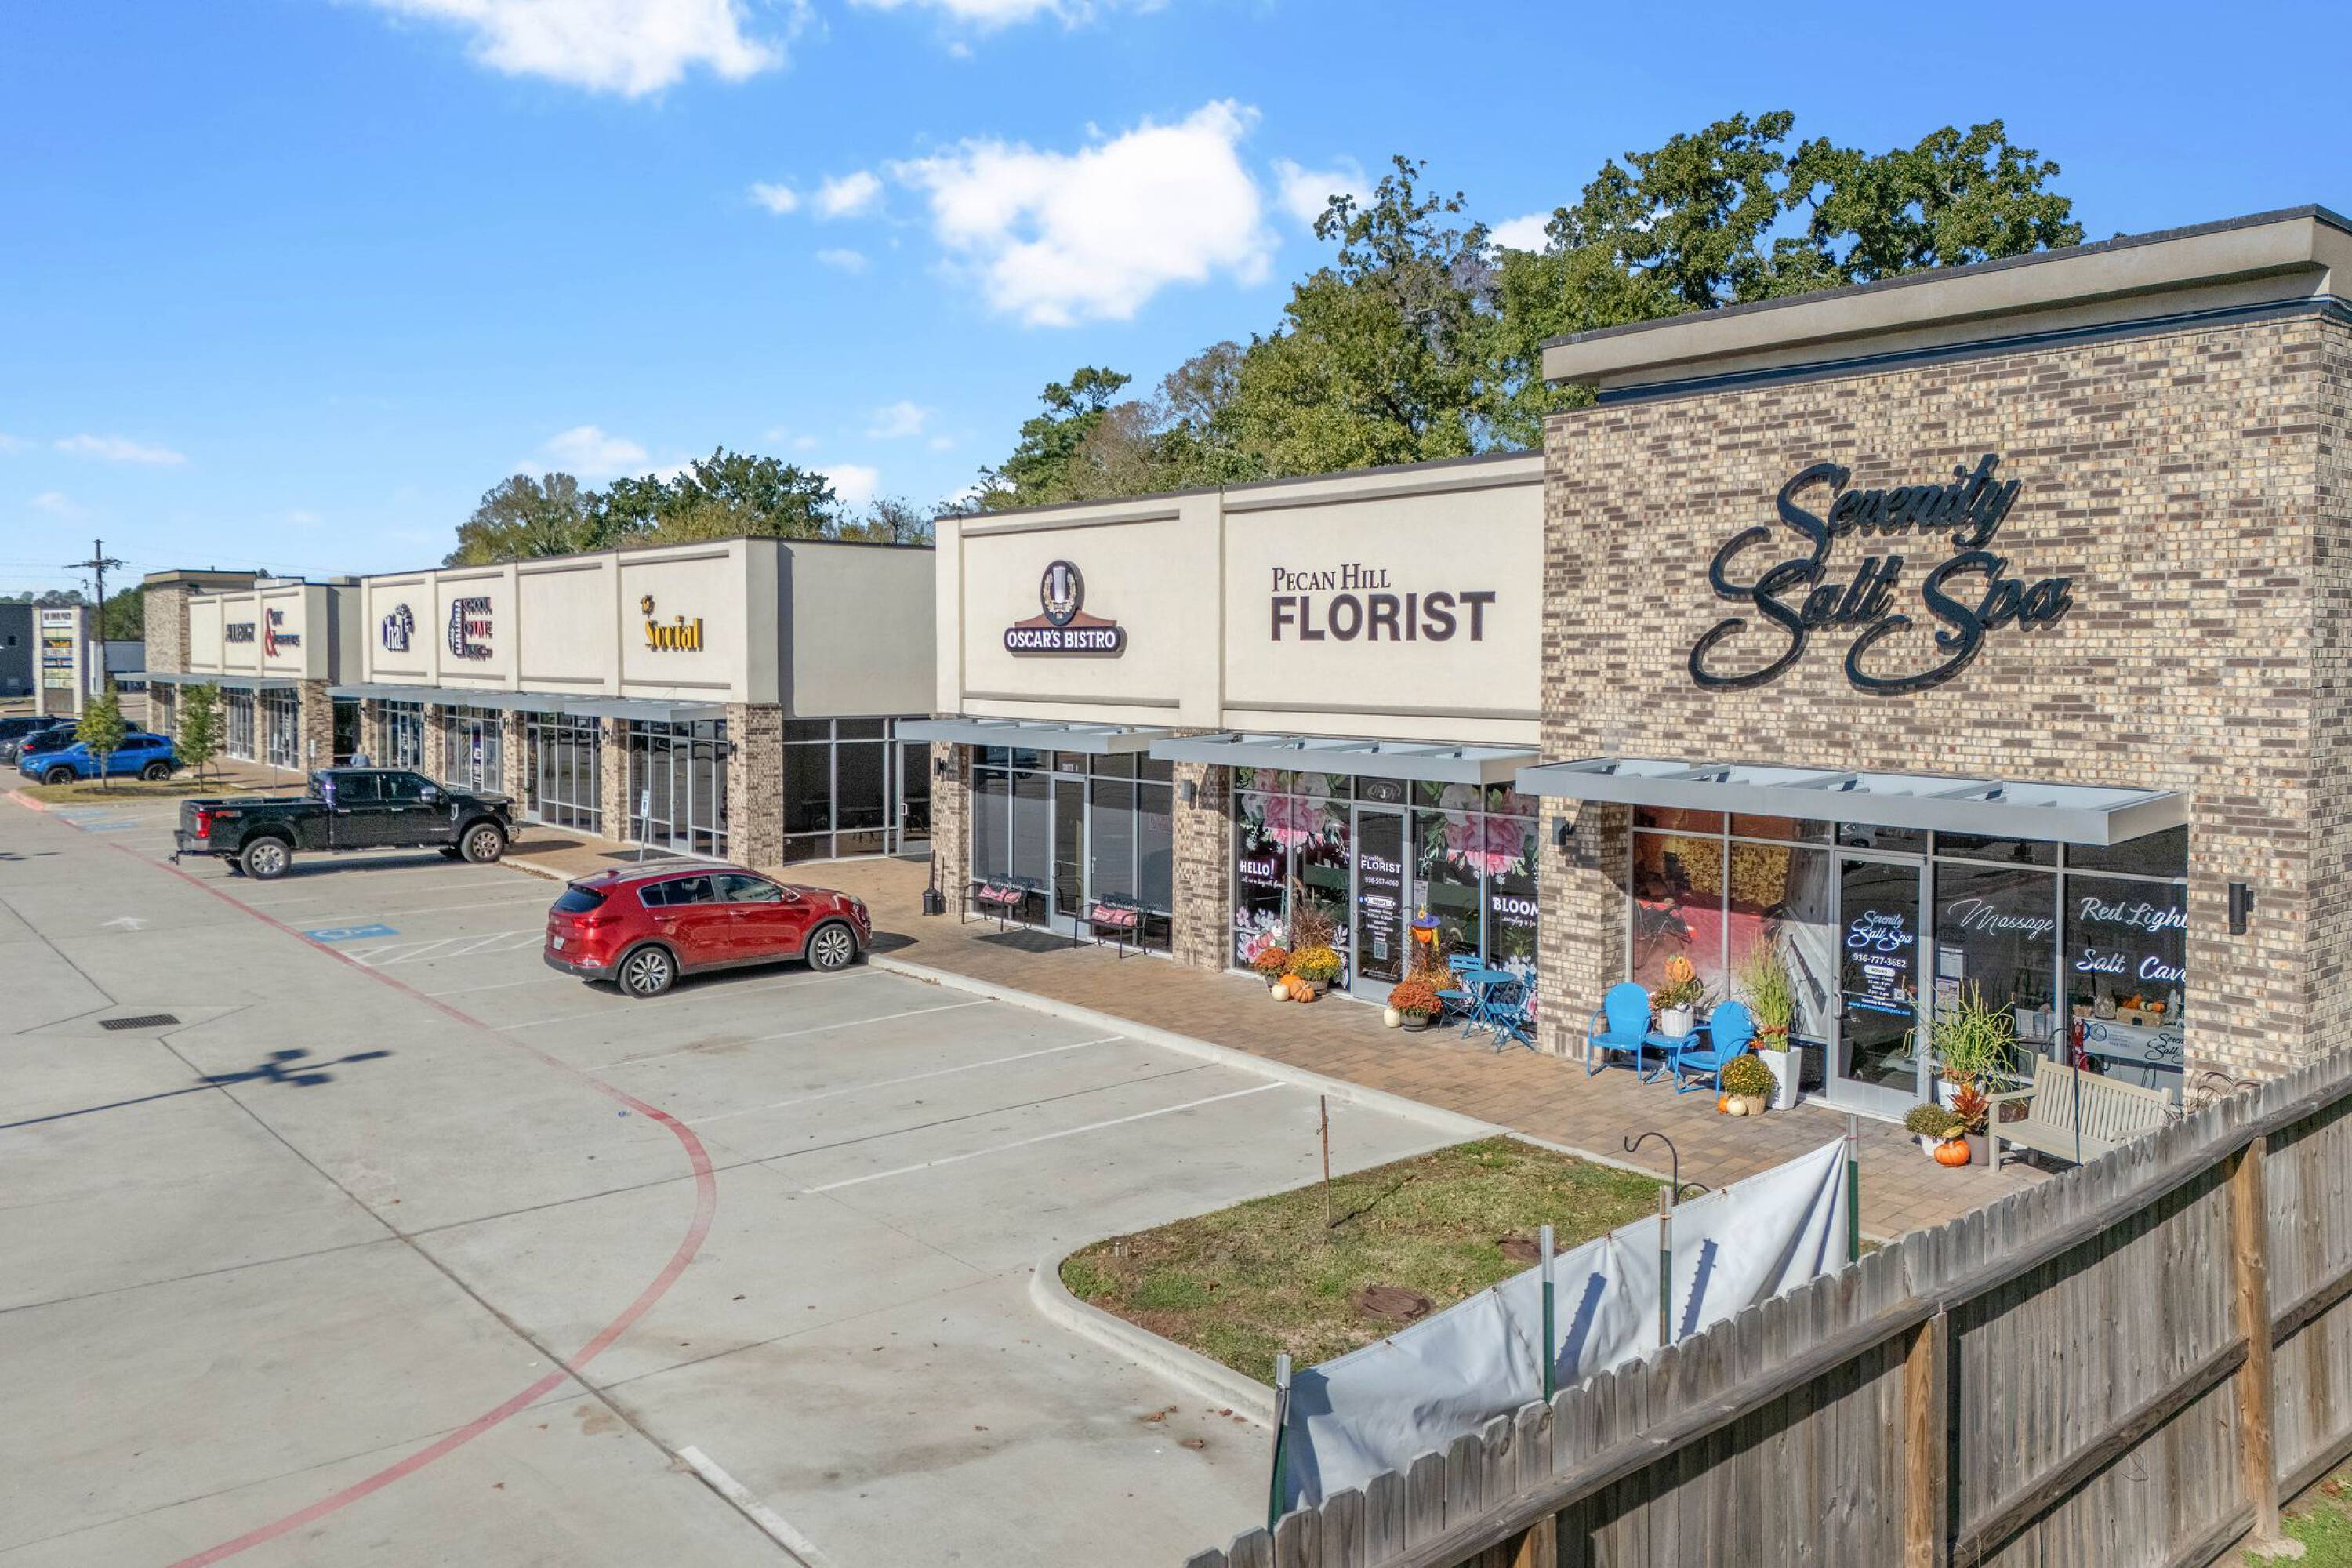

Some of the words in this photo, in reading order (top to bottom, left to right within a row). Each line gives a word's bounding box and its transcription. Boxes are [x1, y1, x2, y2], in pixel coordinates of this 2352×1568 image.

[1710, 454, 2021, 600] Serenity
[1272, 567, 1336, 592] PECAN
[1341, 563, 1392, 590] HILL
[1272, 591, 1496, 641] FLORIST
[1689, 556, 1904, 691] Salt
[1845, 550, 2074, 695] Spa
[644, 615, 703, 651] Social
[1007, 630, 1060, 648] OSCAR'S
[1064, 630, 1116, 648] BISTRO
[1240, 858, 1275, 879] HELLO!
[1361, 859, 1401, 873] FLORIST
[1851, 910, 1905, 931] Serenity
[1947, 898, 2054, 940] Massage
[2080, 897, 2125, 921] Red
[2125, 902, 2187, 931] Light
[1848, 928, 1886, 946] Salt
[1877, 931, 1913, 951] Spa
[2076, 948, 2125, 972] Salt
[2147, 1033, 2183, 1048] Seren
